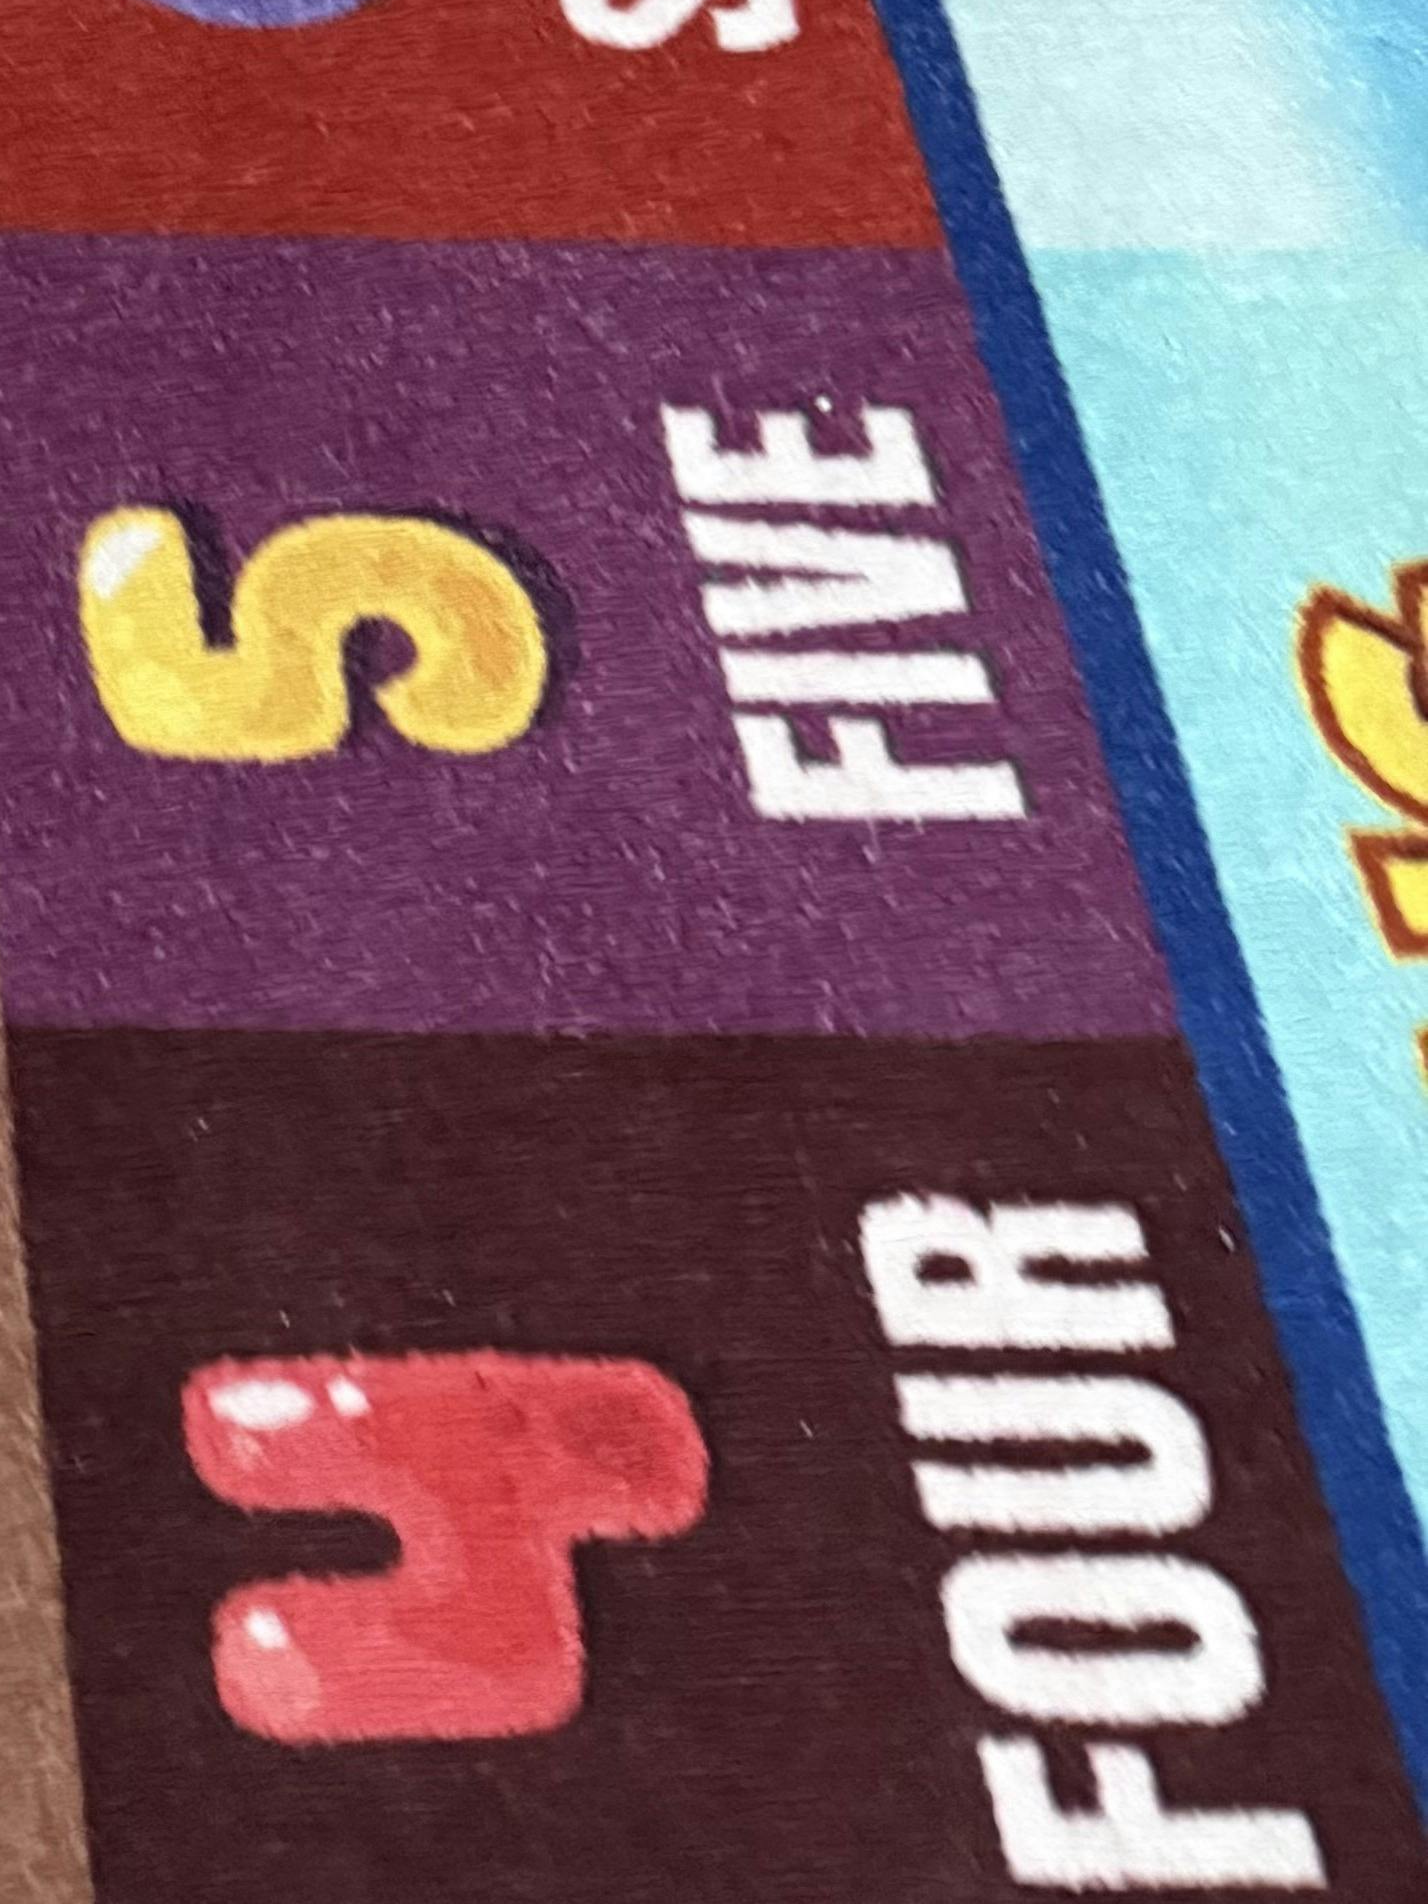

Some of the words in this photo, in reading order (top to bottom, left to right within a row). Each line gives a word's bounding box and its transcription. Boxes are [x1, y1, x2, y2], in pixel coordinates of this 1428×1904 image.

[77, 503, 551, 764] 5
[659, 399, 1031, 823] FIVE
[180, 1347, 711, 1743] 4
[856, 1190, 1329, 1891] FOUR
